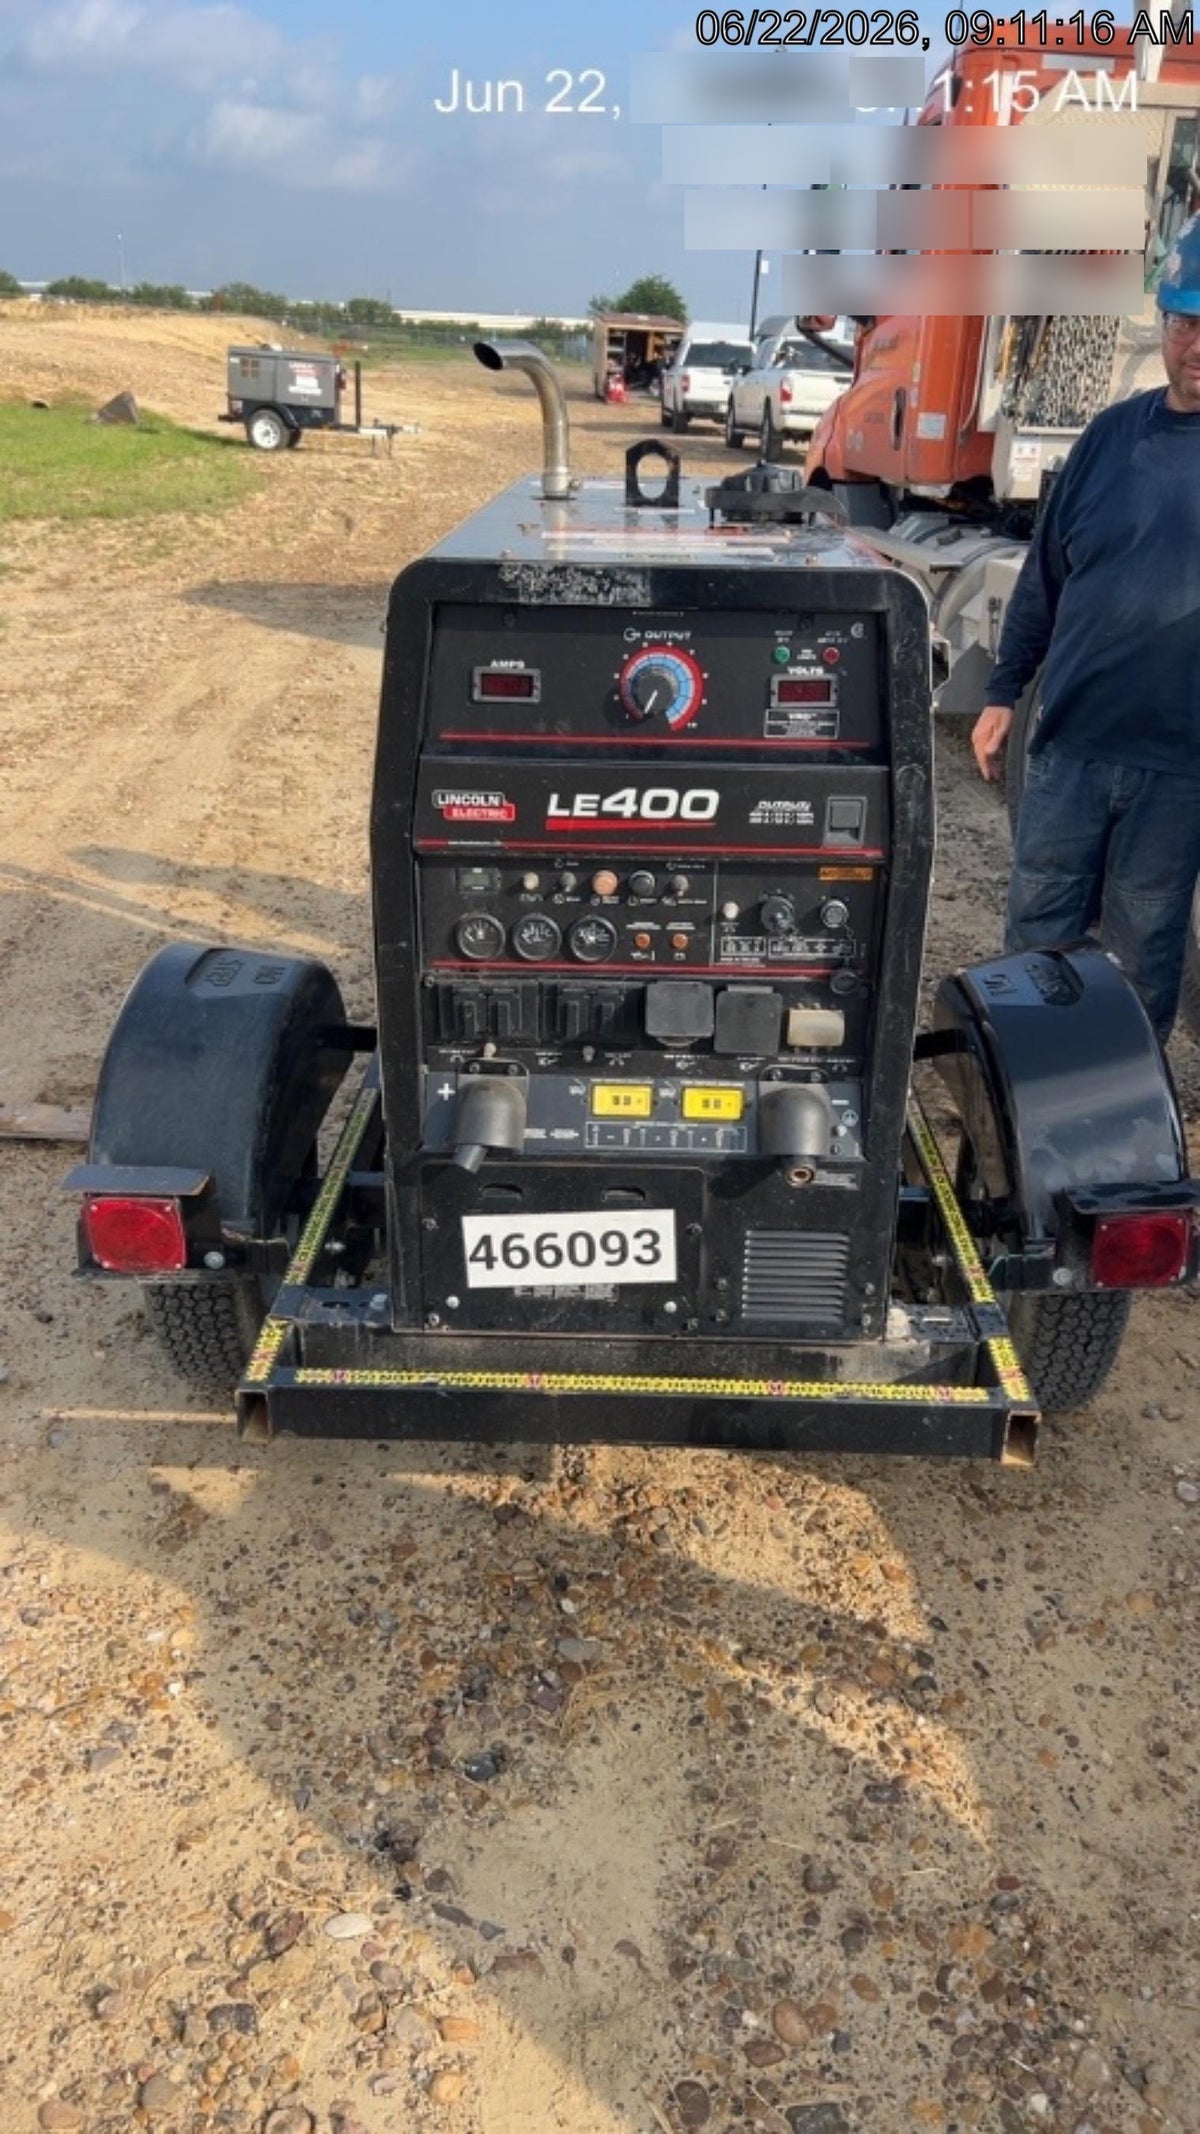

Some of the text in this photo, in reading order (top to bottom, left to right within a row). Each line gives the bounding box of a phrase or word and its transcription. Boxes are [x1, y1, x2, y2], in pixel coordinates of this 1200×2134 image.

[645, 630, 692, 640] OUTPUT
[490, 660, 525, 669] AMPS
[787, 666, 824, 675] VOLTS
[438, 792, 500, 807] LINCOLN
[547, 787, 721, 820] LE400
[452, 807, 508, 818] ELECTRIC
[469, 1228, 662, 1270] 466093
